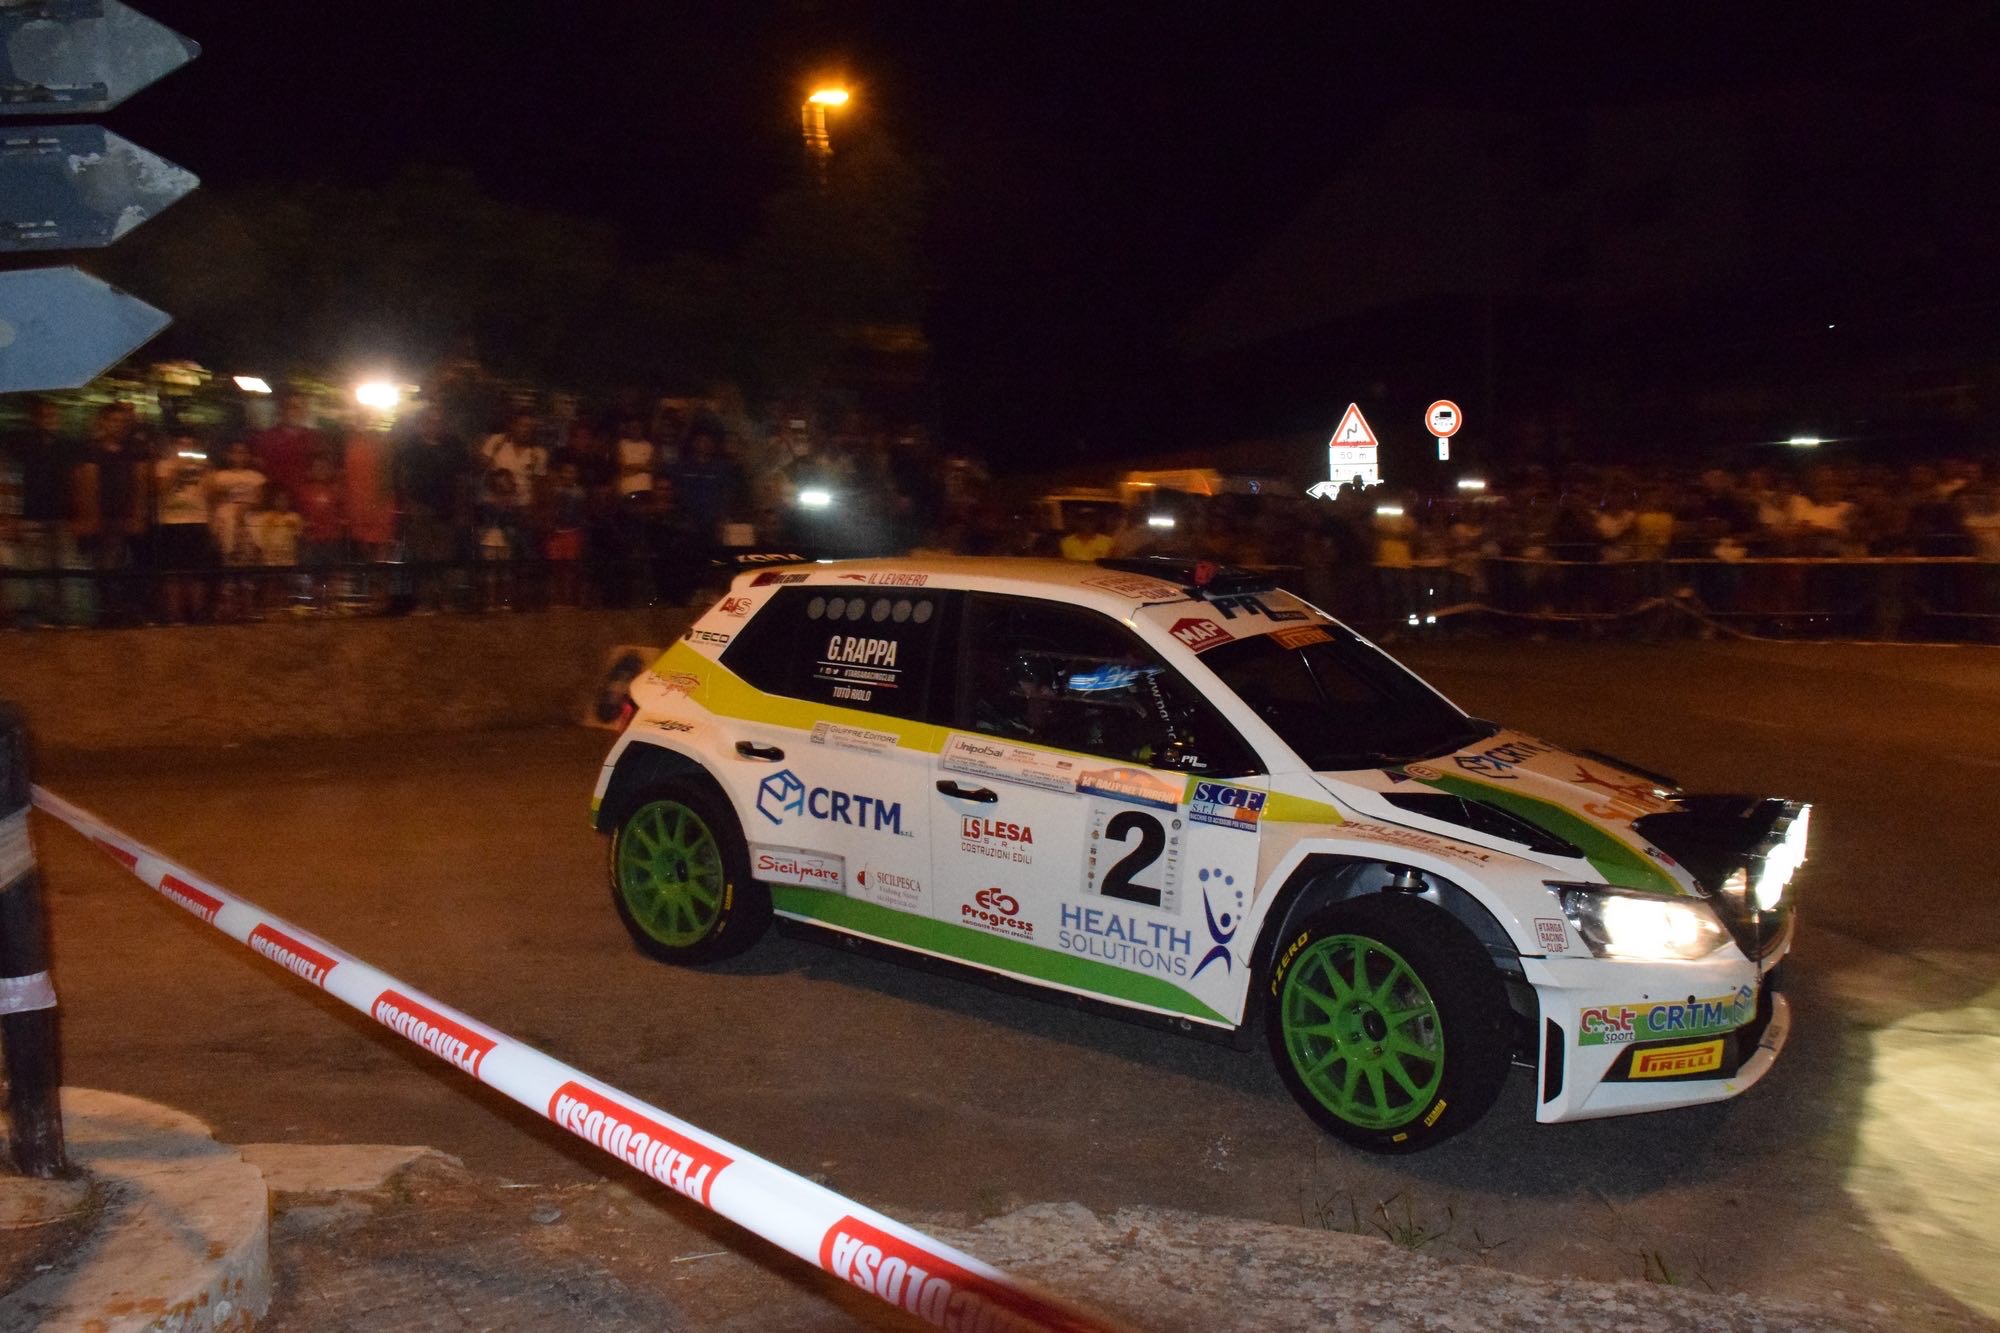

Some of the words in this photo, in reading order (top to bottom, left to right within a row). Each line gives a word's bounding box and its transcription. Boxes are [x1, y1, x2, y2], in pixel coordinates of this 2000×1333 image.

[1340, 451, 1353, 460] 50
[879, 573, 929, 587] LEVRIERO
[695, 630, 730, 643] TECO
[1179, 620, 1224, 646] MAP
[827, 635, 898, 667] G.RAPPA
[955, 740, 1005, 758] UnipolSai
[1192, 803, 1217, 816] s.r.l.
[1195, 783, 1261, 811] S.G.F.
[808, 787, 901, 835] CRTM
[963, 817, 981, 839] LS
[984, 819, 1033, 844] LESA
[961, 842, 1011, 860] COSTRUZIONI
[1012, 852, 1032, 864] EDILI
[1101, 811, 1166, 907] 2
[758, 855, 839, 882] Sicilmare
[876, 872, 922, 892] SICILPESCA
[961, 904, 1034, 932] Progress
[1061, 903, 1192, 955] HEALTH
[1540, 932, 1564, 942] RACING
[1546, 943, 1563, 952] CLUB
[1058, 930, 1188, 977] SOLUTIONS
[1648, 1001, 1723, 1031] CRTM
[1604, 1030, 1635, 1044] sport
[1640, 1046, 1715, 1073] PIRELLI
[553, 1093, 711, 1205] PERICOLOSA
